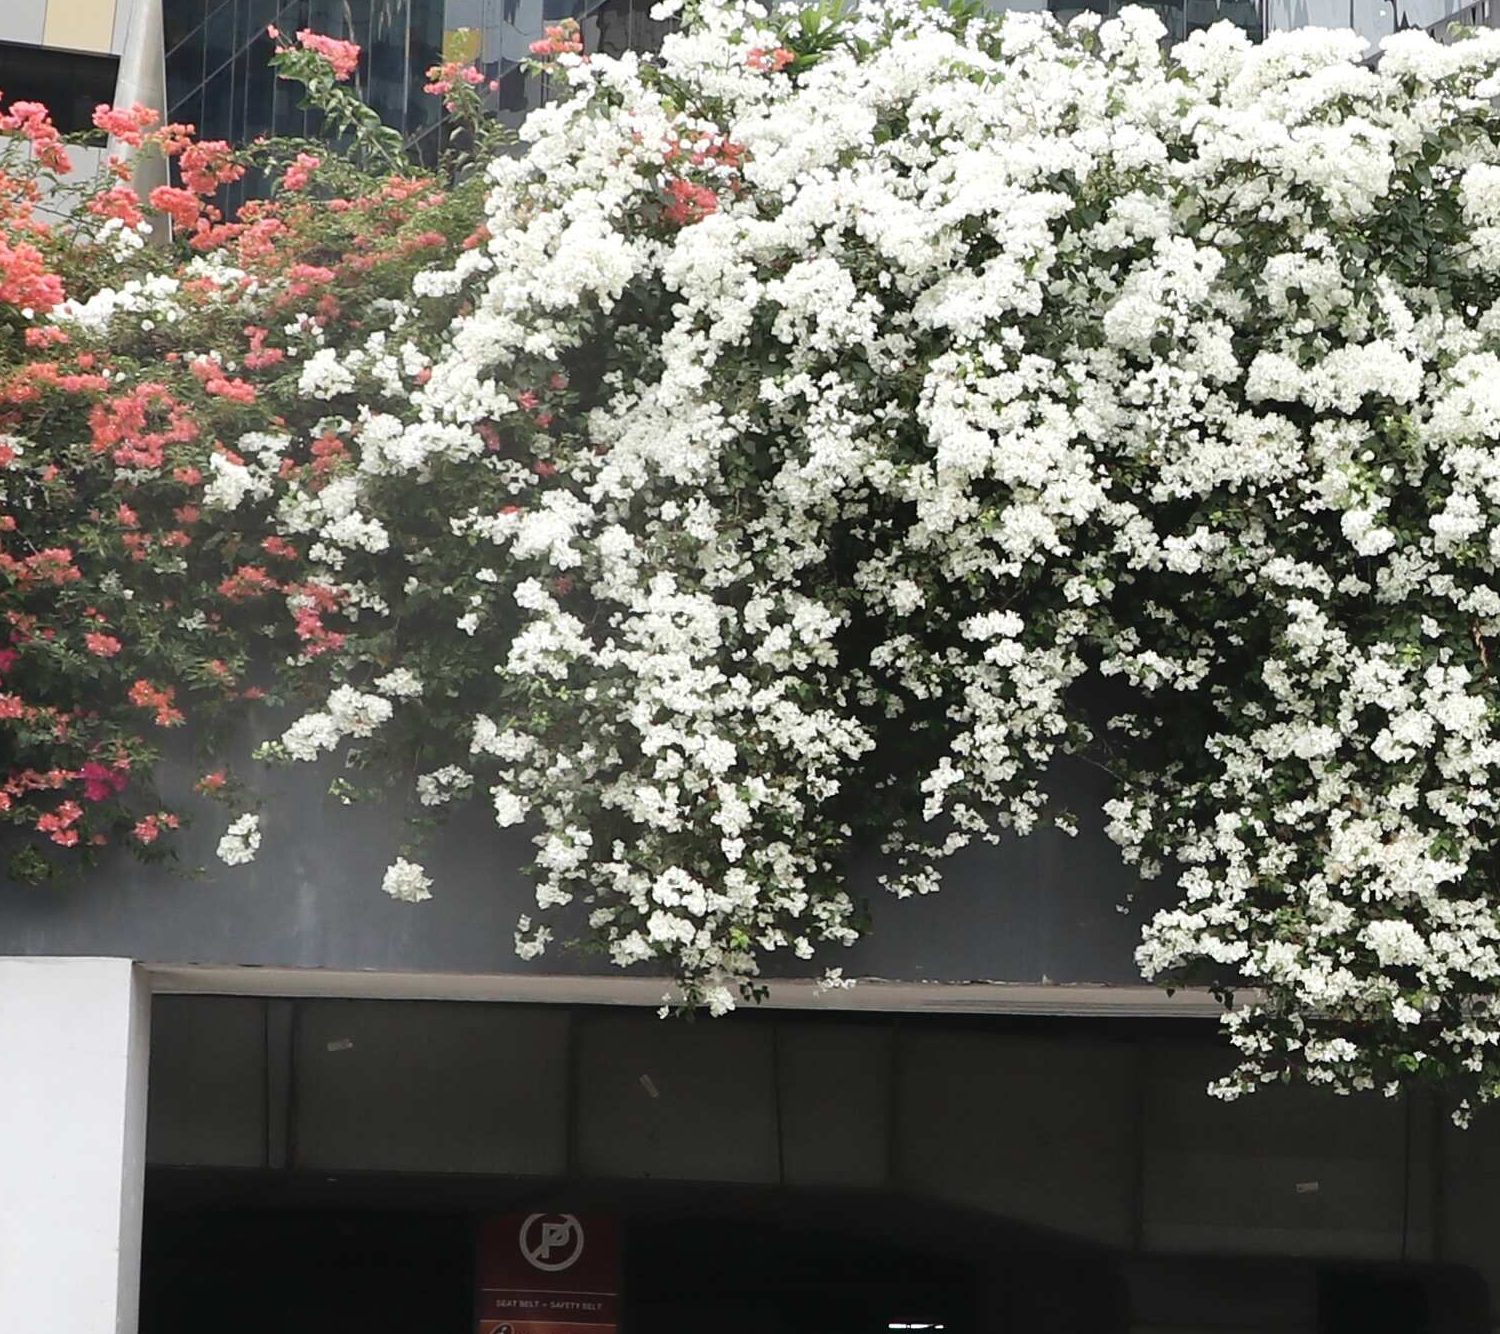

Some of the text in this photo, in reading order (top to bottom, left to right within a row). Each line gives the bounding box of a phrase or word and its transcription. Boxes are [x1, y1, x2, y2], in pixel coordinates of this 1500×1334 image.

[496, 1299, 517, 1308] SEAT
[520, 1299, 539, 1308] BELT
[550, 1300, 580, 1310] SAFETY
[582, 1302, 602, 1311] BELT
